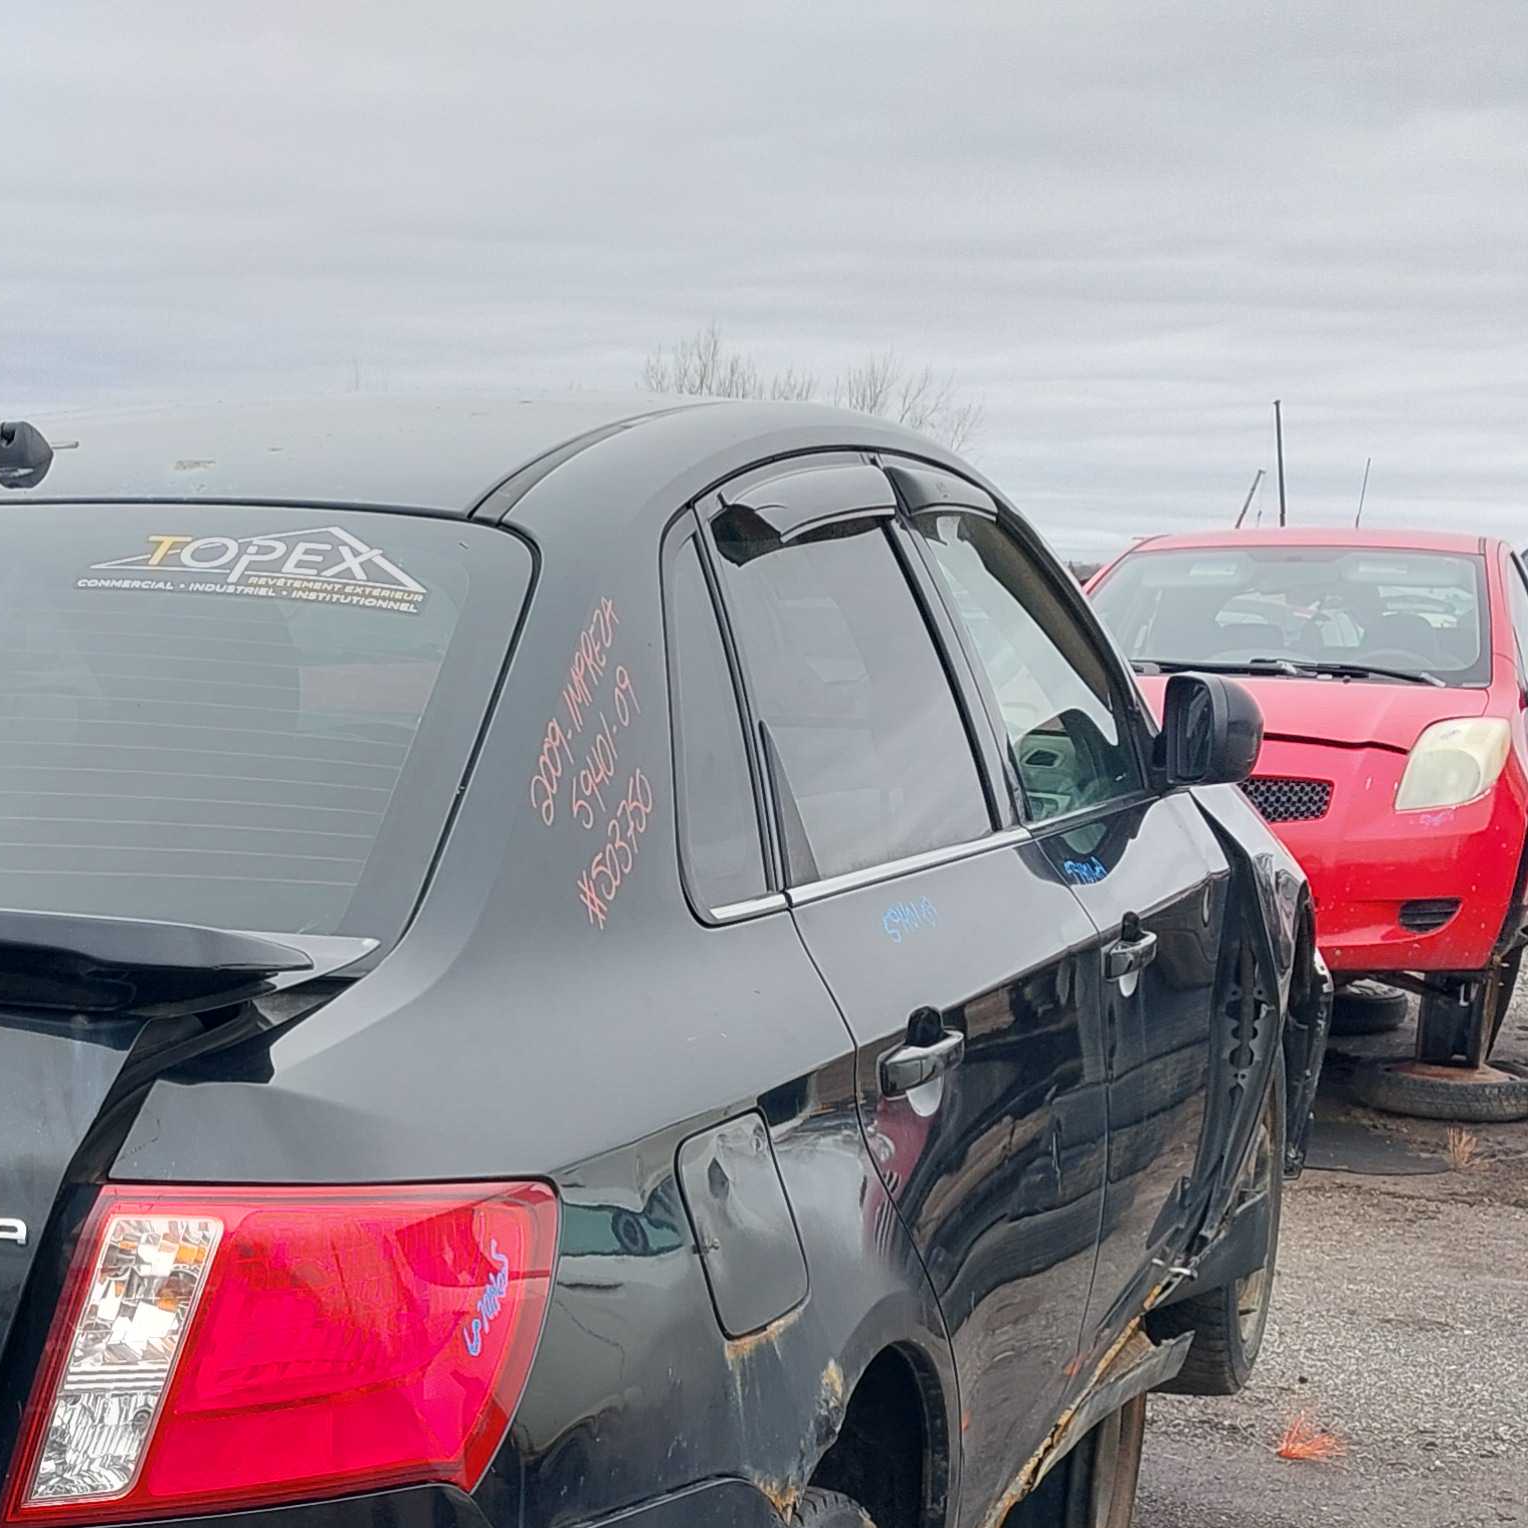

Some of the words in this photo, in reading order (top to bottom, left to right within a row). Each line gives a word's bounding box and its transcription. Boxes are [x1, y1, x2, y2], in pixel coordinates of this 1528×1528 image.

[146, 534, 383, 584] TOPEX
[76, 578, 174, 591] COMMERCIAL
[188, 581, 277, 597] INDUSTRIEL
[290, 590, 419, 614] INSTITUTIONNEL
